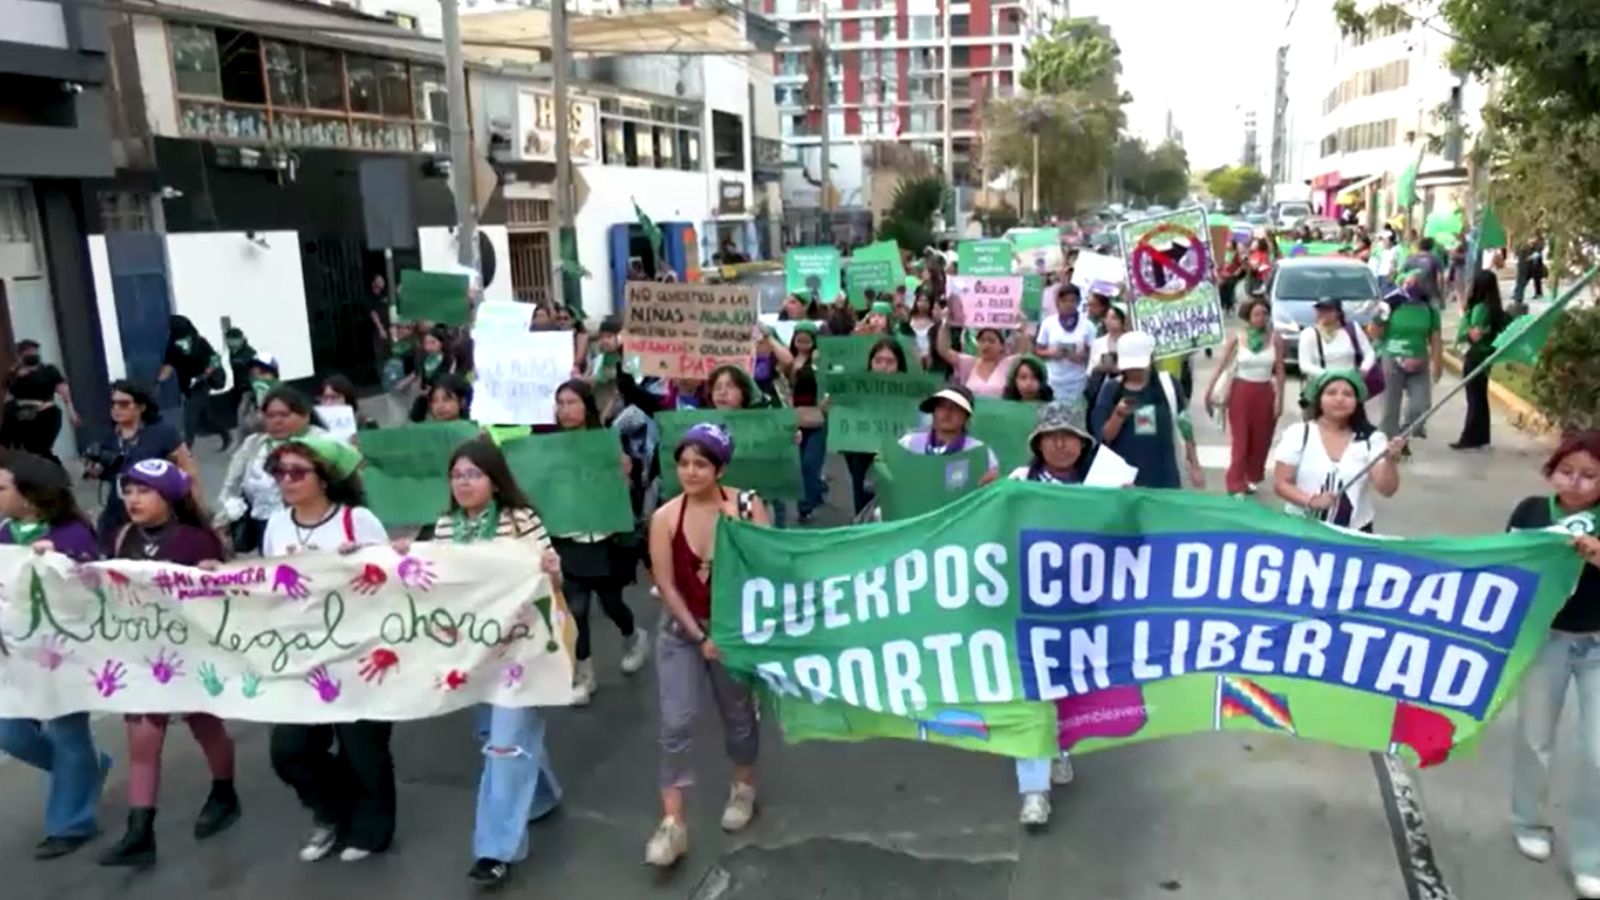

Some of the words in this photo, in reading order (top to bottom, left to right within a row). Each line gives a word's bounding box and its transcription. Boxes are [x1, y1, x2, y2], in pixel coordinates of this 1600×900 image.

[741, 543, 1009, 644] CUERPOS
[1028, 541, 1151, 606] CON
[1172, 543, 1519, 633] DIGNIDAD
[1030, 625, 1110, 701] EN
[1132, 619, 1489, 707] LIBERTAD
